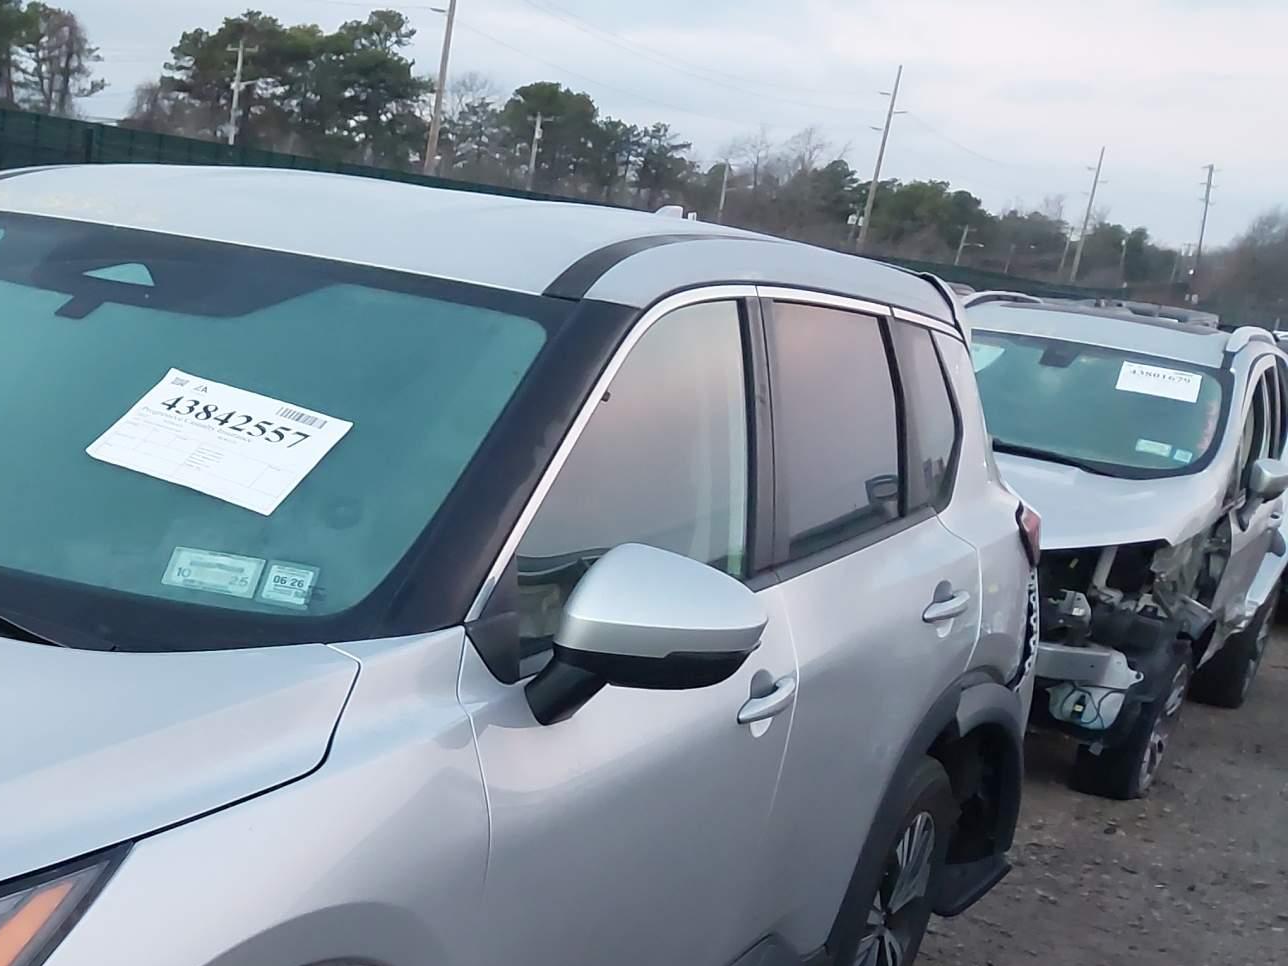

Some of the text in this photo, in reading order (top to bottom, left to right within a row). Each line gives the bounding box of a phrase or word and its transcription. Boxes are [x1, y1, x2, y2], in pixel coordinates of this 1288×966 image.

[161, 396, 310, 449] 43842557
[272, 575, 305, 588] 06 26
